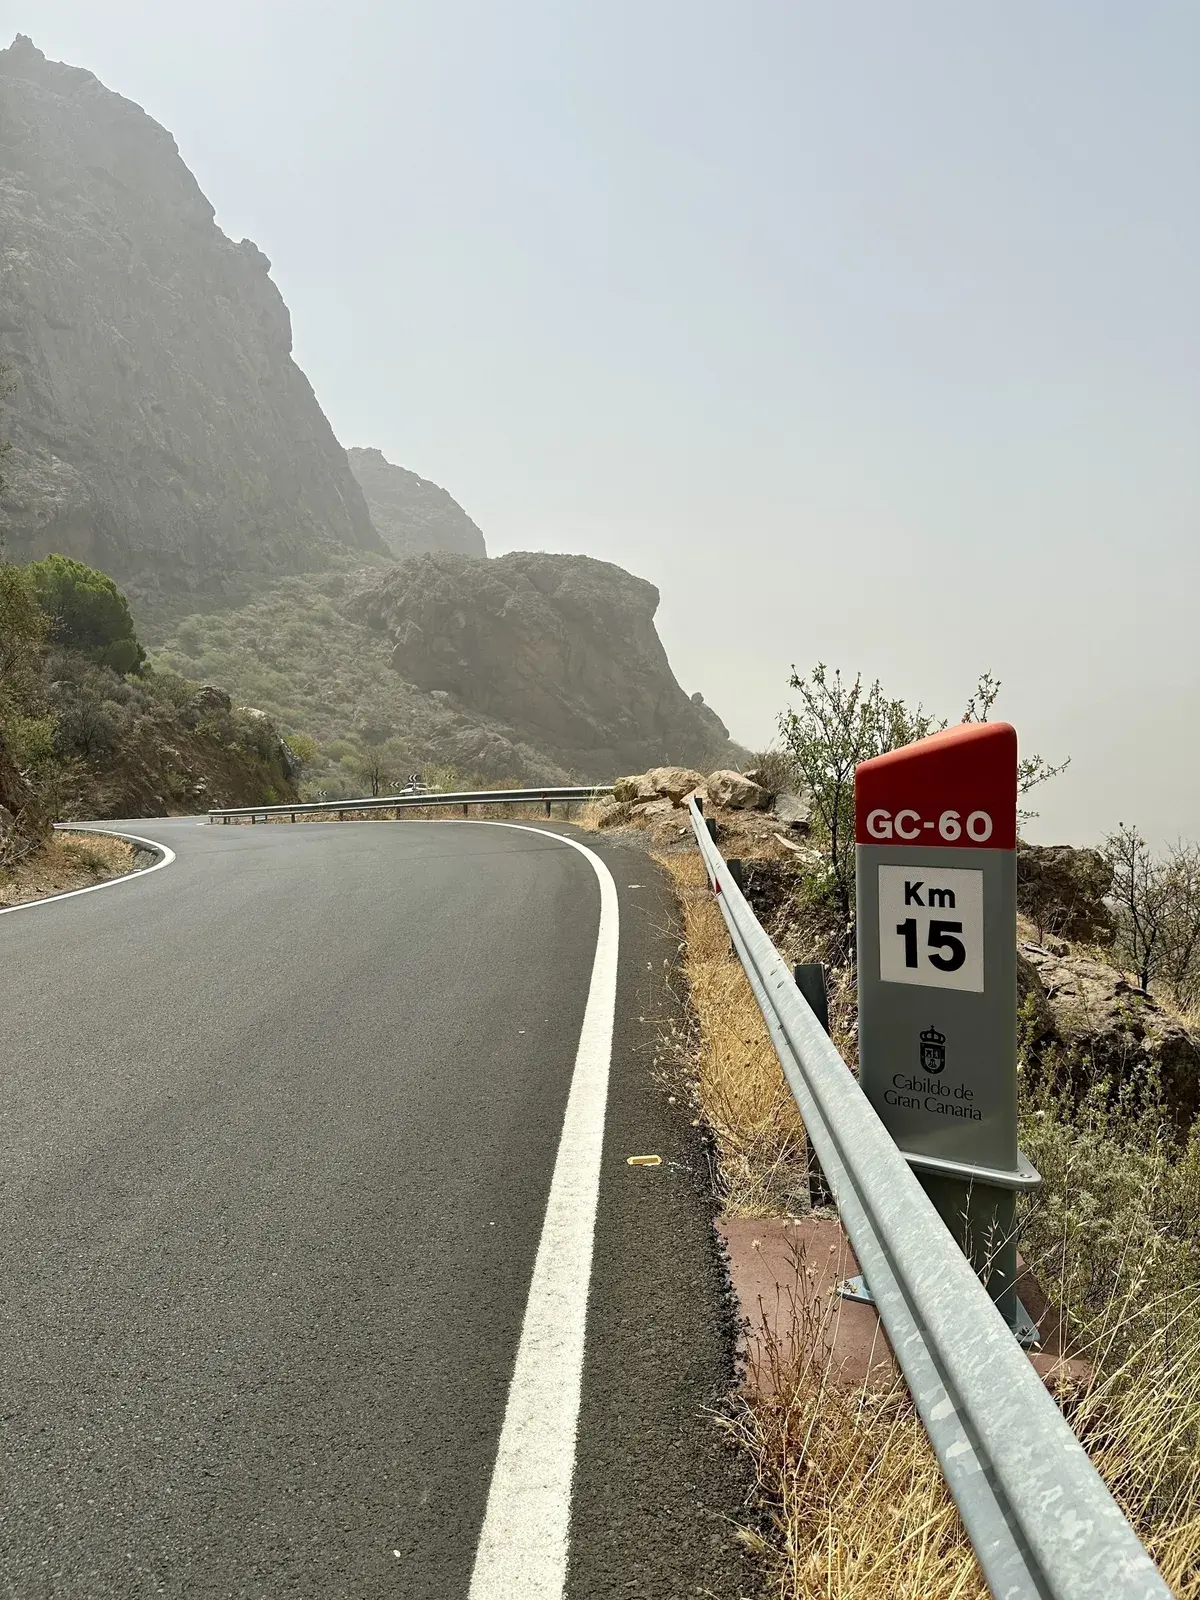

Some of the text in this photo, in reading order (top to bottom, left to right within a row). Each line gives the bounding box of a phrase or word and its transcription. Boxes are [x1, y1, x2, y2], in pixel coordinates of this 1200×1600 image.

[866, 808, 993, 842] GC-60
[904, 881, 956, 908] Km
[896, 918, 966, 972] 15
[892, 1073, 974, 1101] Cabildo de
[884, 1089, 983, 1121] Gran Canaria
